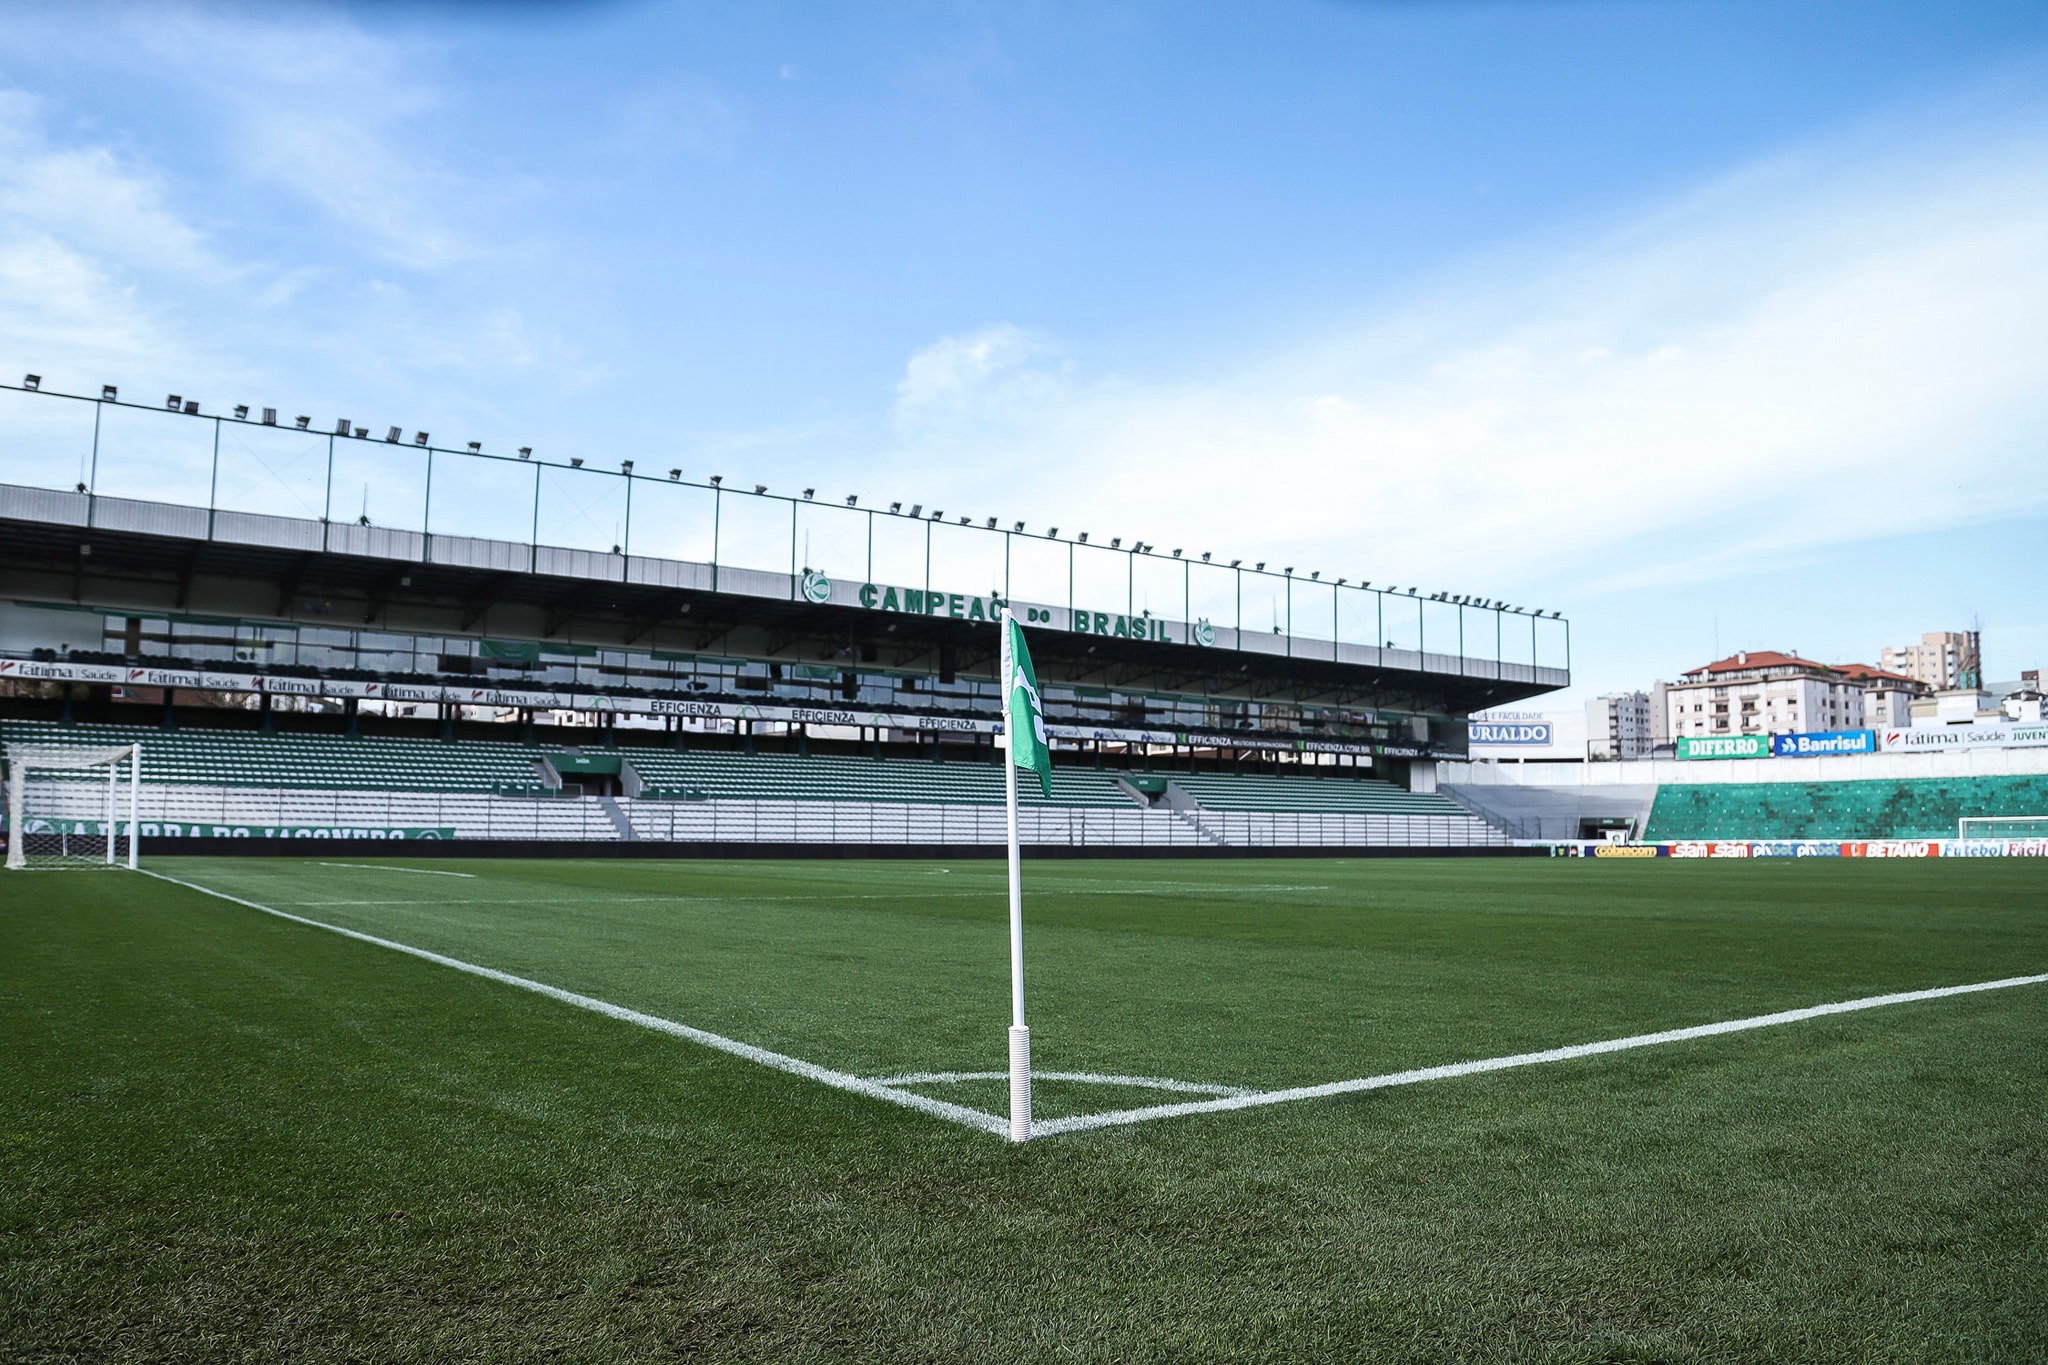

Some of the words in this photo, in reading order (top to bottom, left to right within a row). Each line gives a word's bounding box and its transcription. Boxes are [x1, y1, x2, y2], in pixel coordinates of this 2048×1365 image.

[1027, 607, 1050, 623] DO
[1074, 610, 1172, 643] BRASIL
[651, 700, 722, 715] EFFICIENZA
[792, 709, 856, 724] EFFICIENZA
[919, 717, 977, 731] EFFICIENZA
[1188, 735, 1231, 746] EFFICIENZA
[1798, 733, 1866, 752] Banrisul
[1905, 731, 1958, 745] fátima
[1967, 730, 2005, 742] Saúde
[2013, 730, 2048, 741] JUVEN
[1688, 738, 1759, 756] DIFERRO
[1865, 843, 1930, 857] BETANO
[1943, 844, 2004, 857] Futebol
